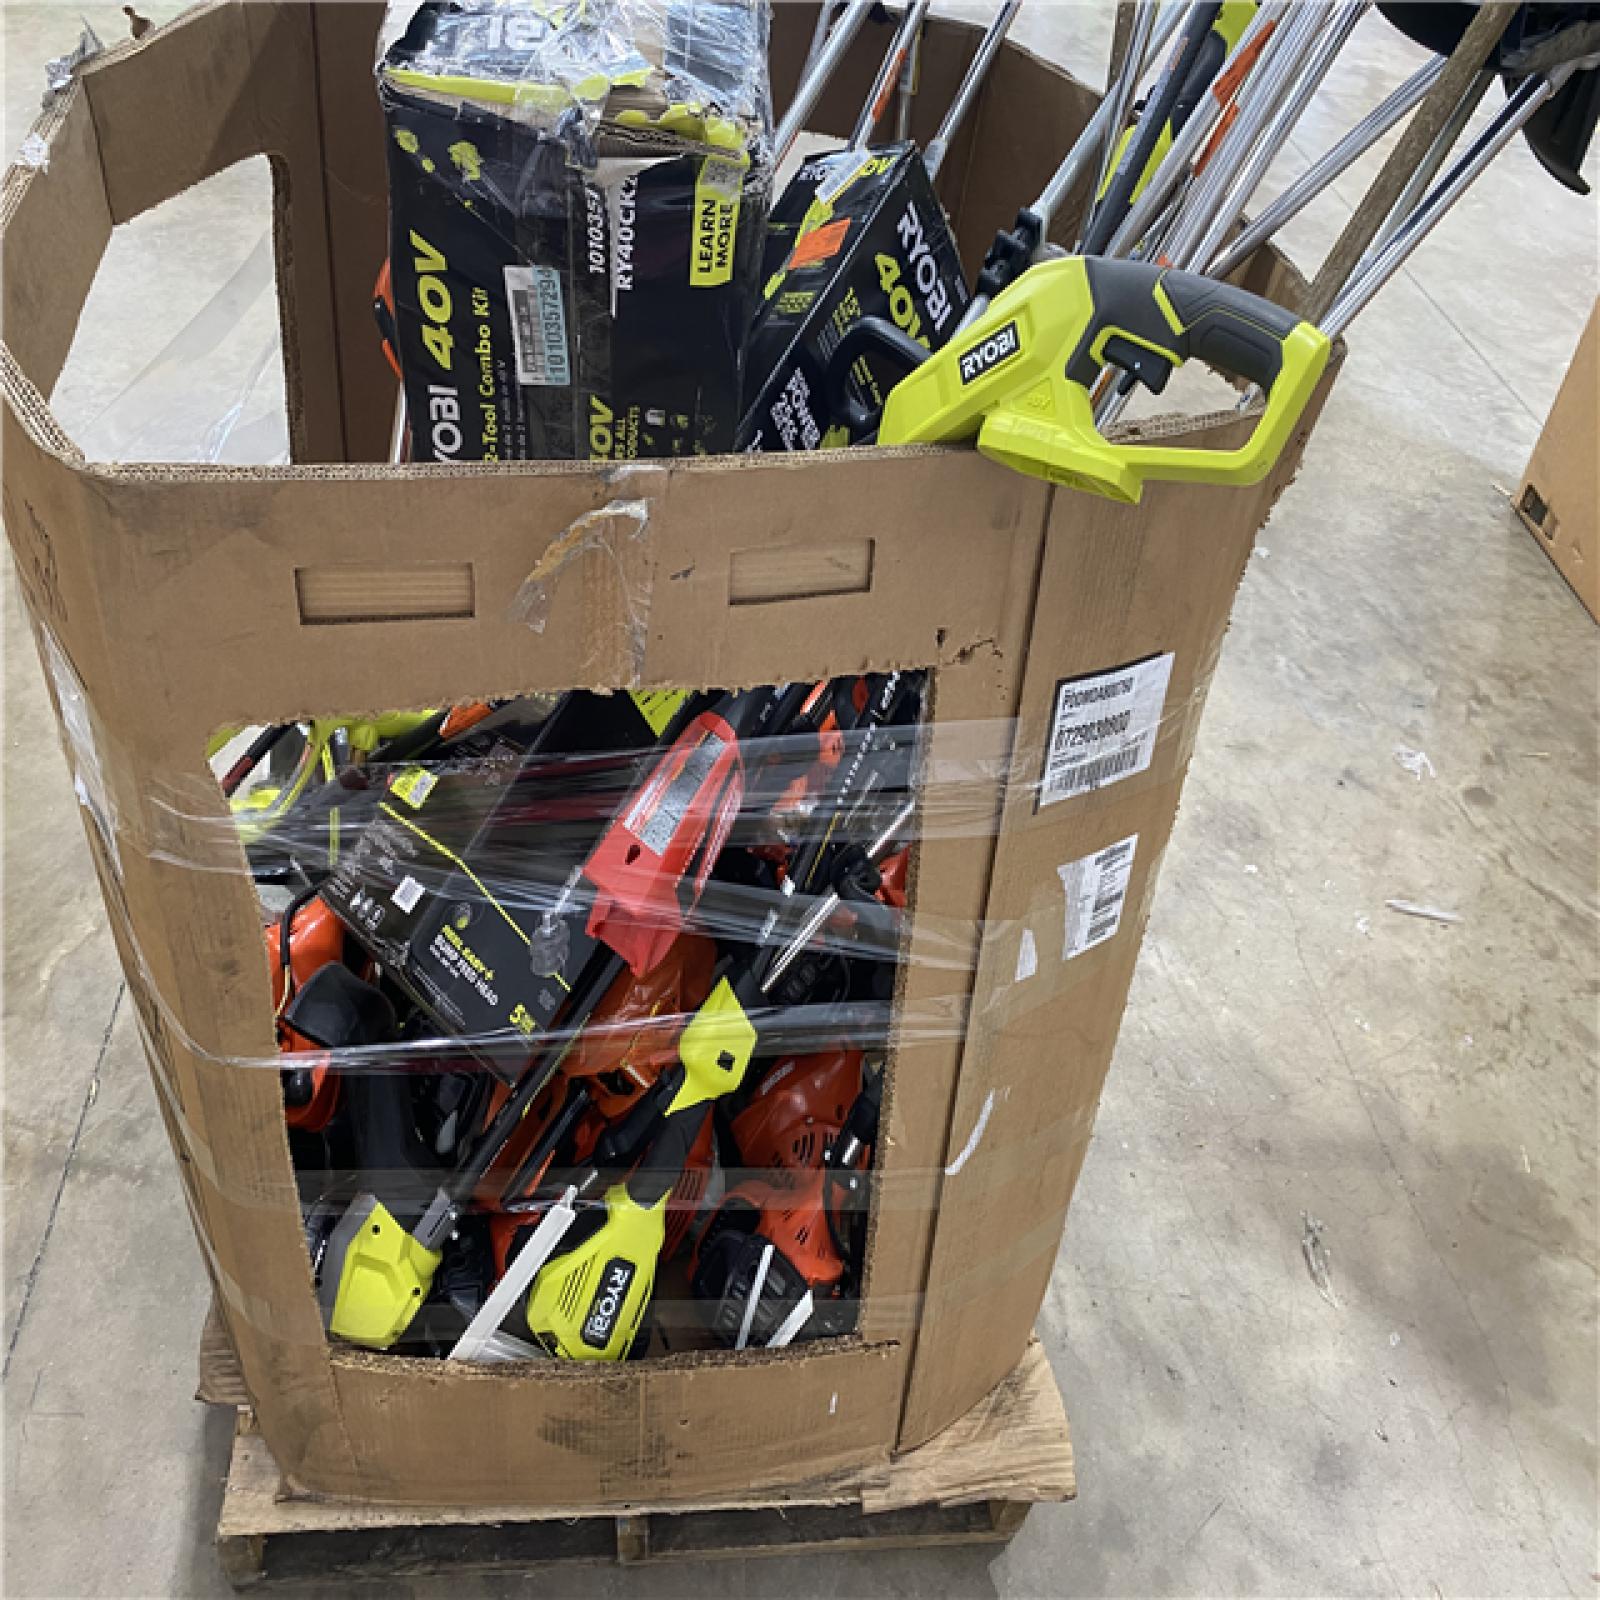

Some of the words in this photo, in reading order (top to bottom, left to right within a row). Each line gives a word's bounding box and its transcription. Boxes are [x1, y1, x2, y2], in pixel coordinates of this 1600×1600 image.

[698, 199, 717, 273] LEARN
[715, 204, 733, 268] MORE
[897, 199, 953, 336] RYOBI
[409, 229, 454, 370] 40V
[471, 286, 491, 318] Kit
[474, 324, 495, 396] Combo
[960, 326, 1016, 379] RYOBI
[479, 402, 499, 463] 2-Tool
[584, 1265, 631, 1338] RYOBI
